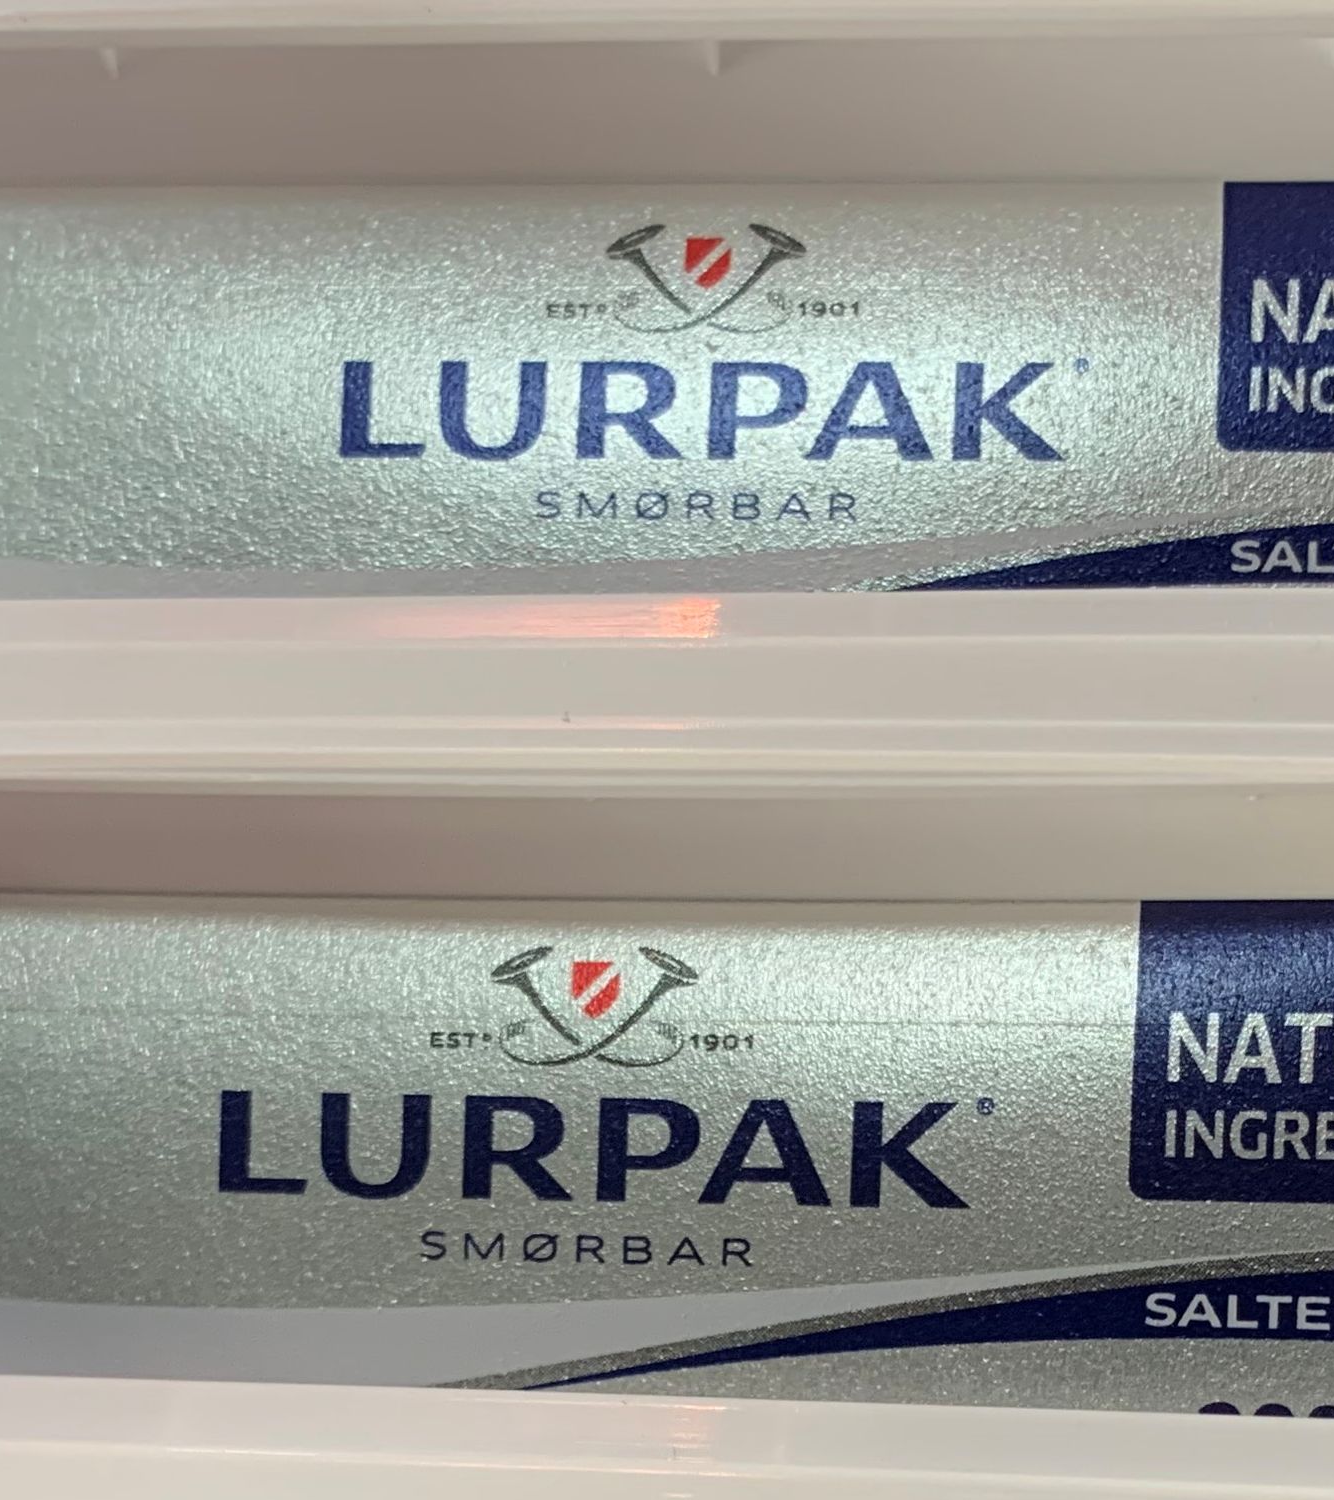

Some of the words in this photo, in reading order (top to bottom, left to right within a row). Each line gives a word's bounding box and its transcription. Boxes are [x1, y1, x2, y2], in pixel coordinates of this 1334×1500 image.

[798, 301, 860, 317] 1901
[535, 491, 857, 523] SMØRBAR
[690, 1032, 754, 1051] 1901
[420, 1231, 753, 1268] SMØRBAR
